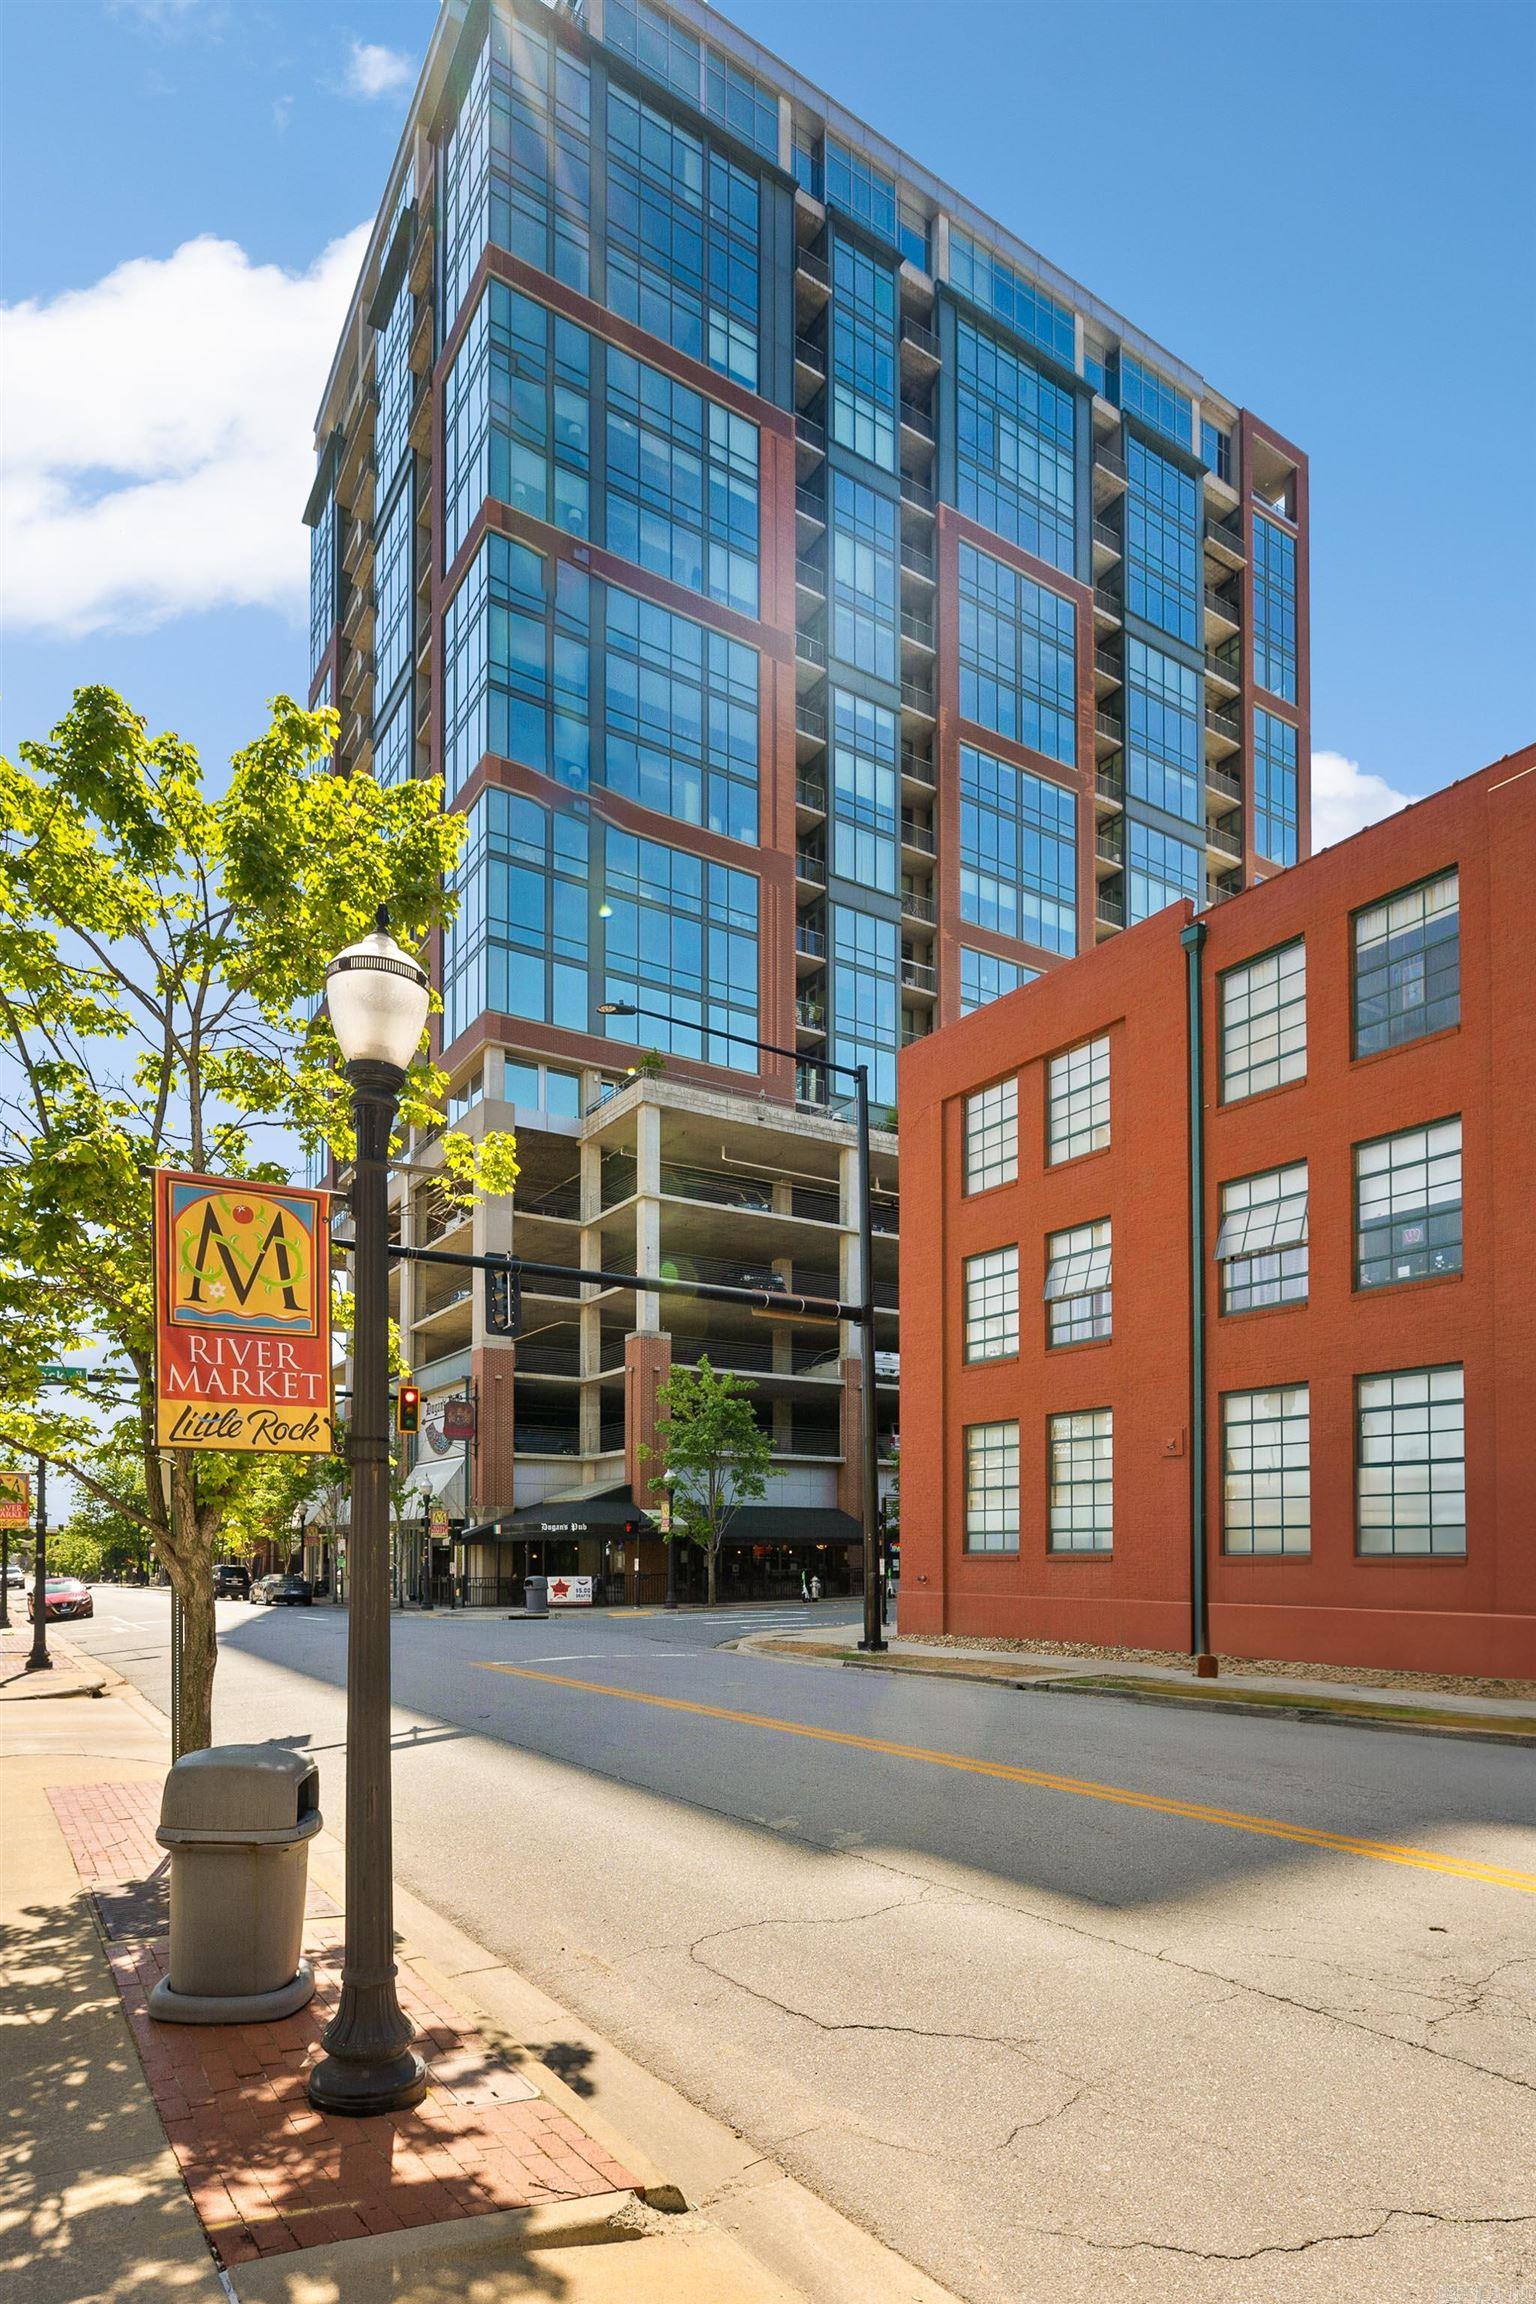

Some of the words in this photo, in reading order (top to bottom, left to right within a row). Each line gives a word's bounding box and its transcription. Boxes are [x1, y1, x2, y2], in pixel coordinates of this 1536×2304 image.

[183, 1201, 308, 1312] M
[188, 1335, 303, 1370] RIVER
[166, 1363, 323, 1400] MARKET
[169, 1404, 244, 1442] Little
[247, 1409, 320, 1446] Rock
[541, 1522, 568, 1532] Dugan's
[570, 1522, 588, 1532] Pub
